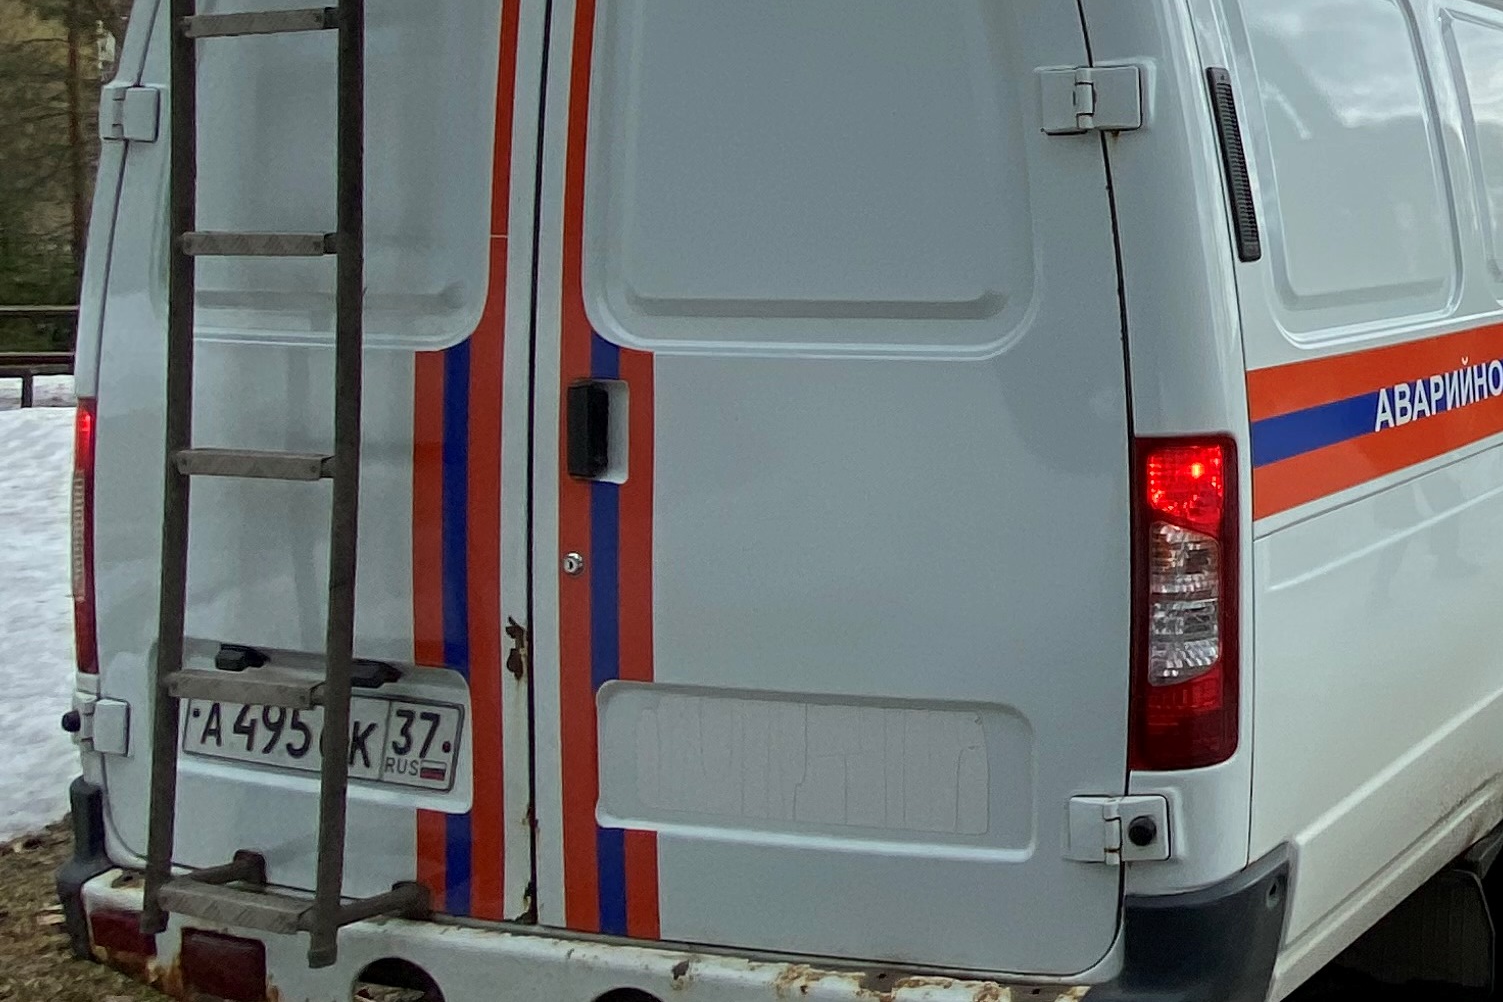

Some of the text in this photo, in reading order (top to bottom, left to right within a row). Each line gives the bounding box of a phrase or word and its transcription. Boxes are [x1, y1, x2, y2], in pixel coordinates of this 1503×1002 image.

[1374, 356, 1503, 432] АВАРИЙНО
[200, 702, 441, 768] А495К 37
[385, 756, 420, 777] RUS
